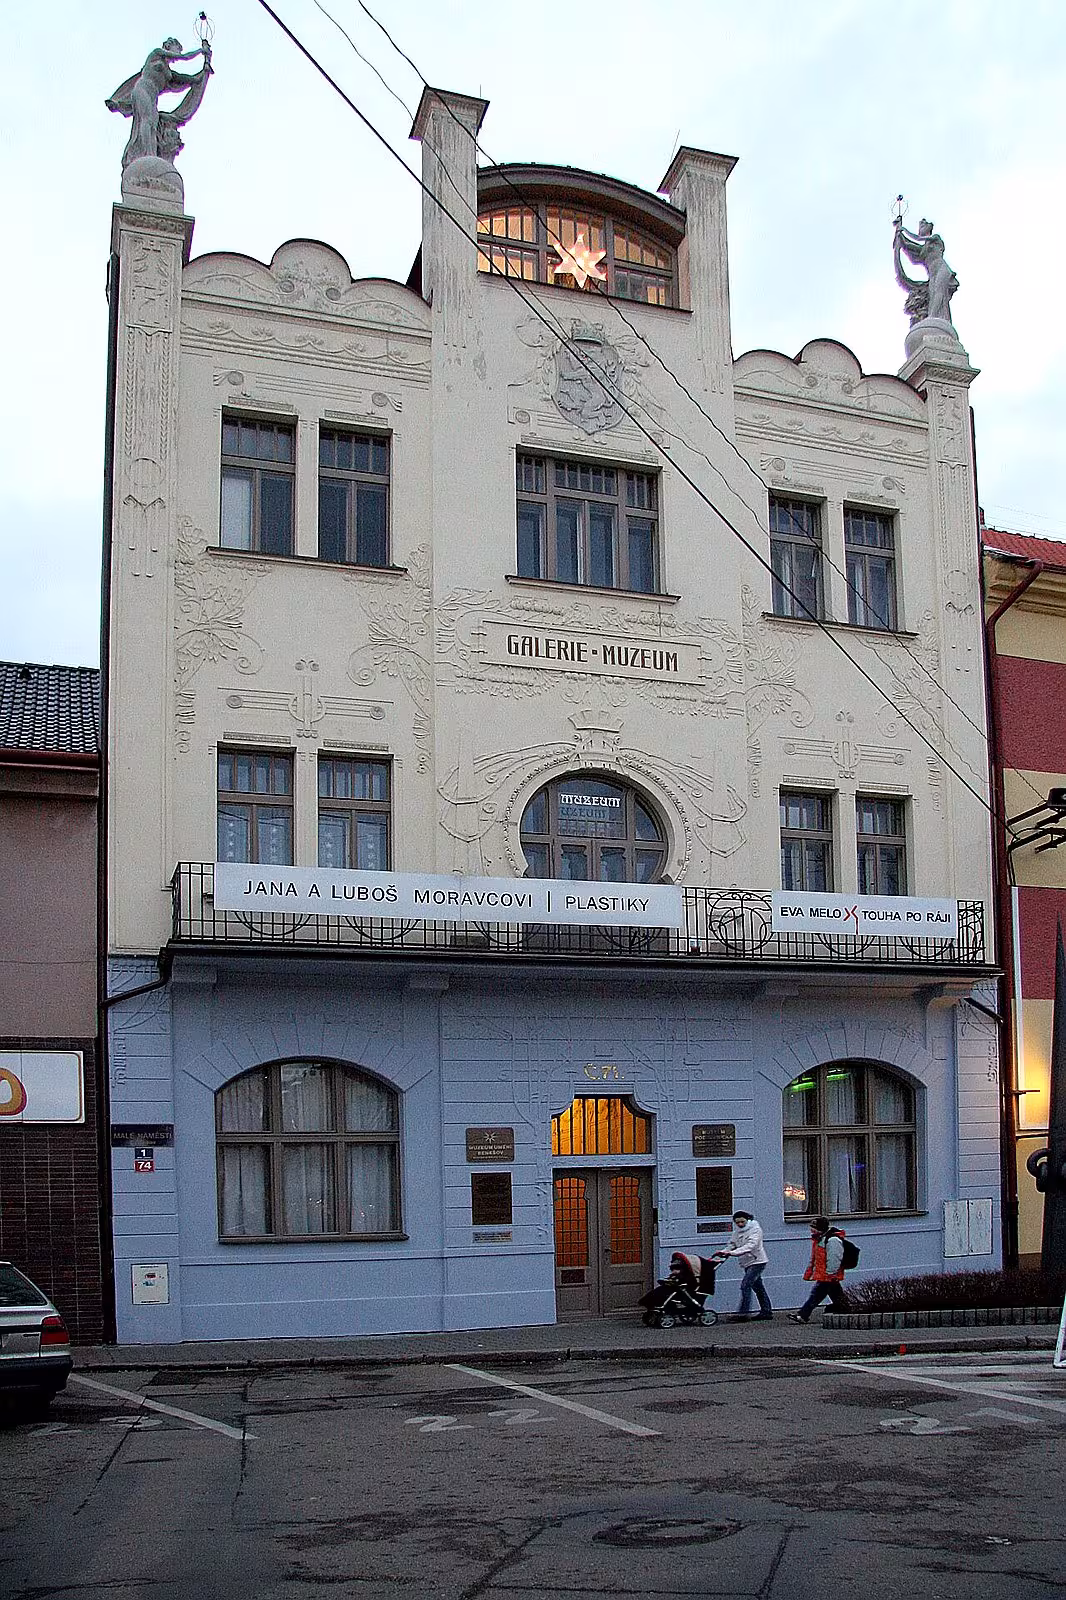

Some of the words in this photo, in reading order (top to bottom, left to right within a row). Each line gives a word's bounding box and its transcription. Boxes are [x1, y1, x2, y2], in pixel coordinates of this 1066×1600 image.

[507, 634, 588, 663] GALERIE
[602, 645, 678, 672] MUZEUM
[243, 880, 298, 897] JANA
[308, 884, 321, 898] A
[331, 884, 398, 902] LUBOŠ
[414, 889, 532, 908] MORAVCOVI
[565, 896, 650, 912] PLASTIKY
[780, 907, 804, 917] EVA
[809, 908, 842, 919] MELO
[862, 911, 901, 921] TOUHA
[906, 912, 922, 922] PO
[926, 910, 951, 923] RÁJI
[140, 1149, 146, 1157] 1
[137, 1161, 152, 1170] 74
